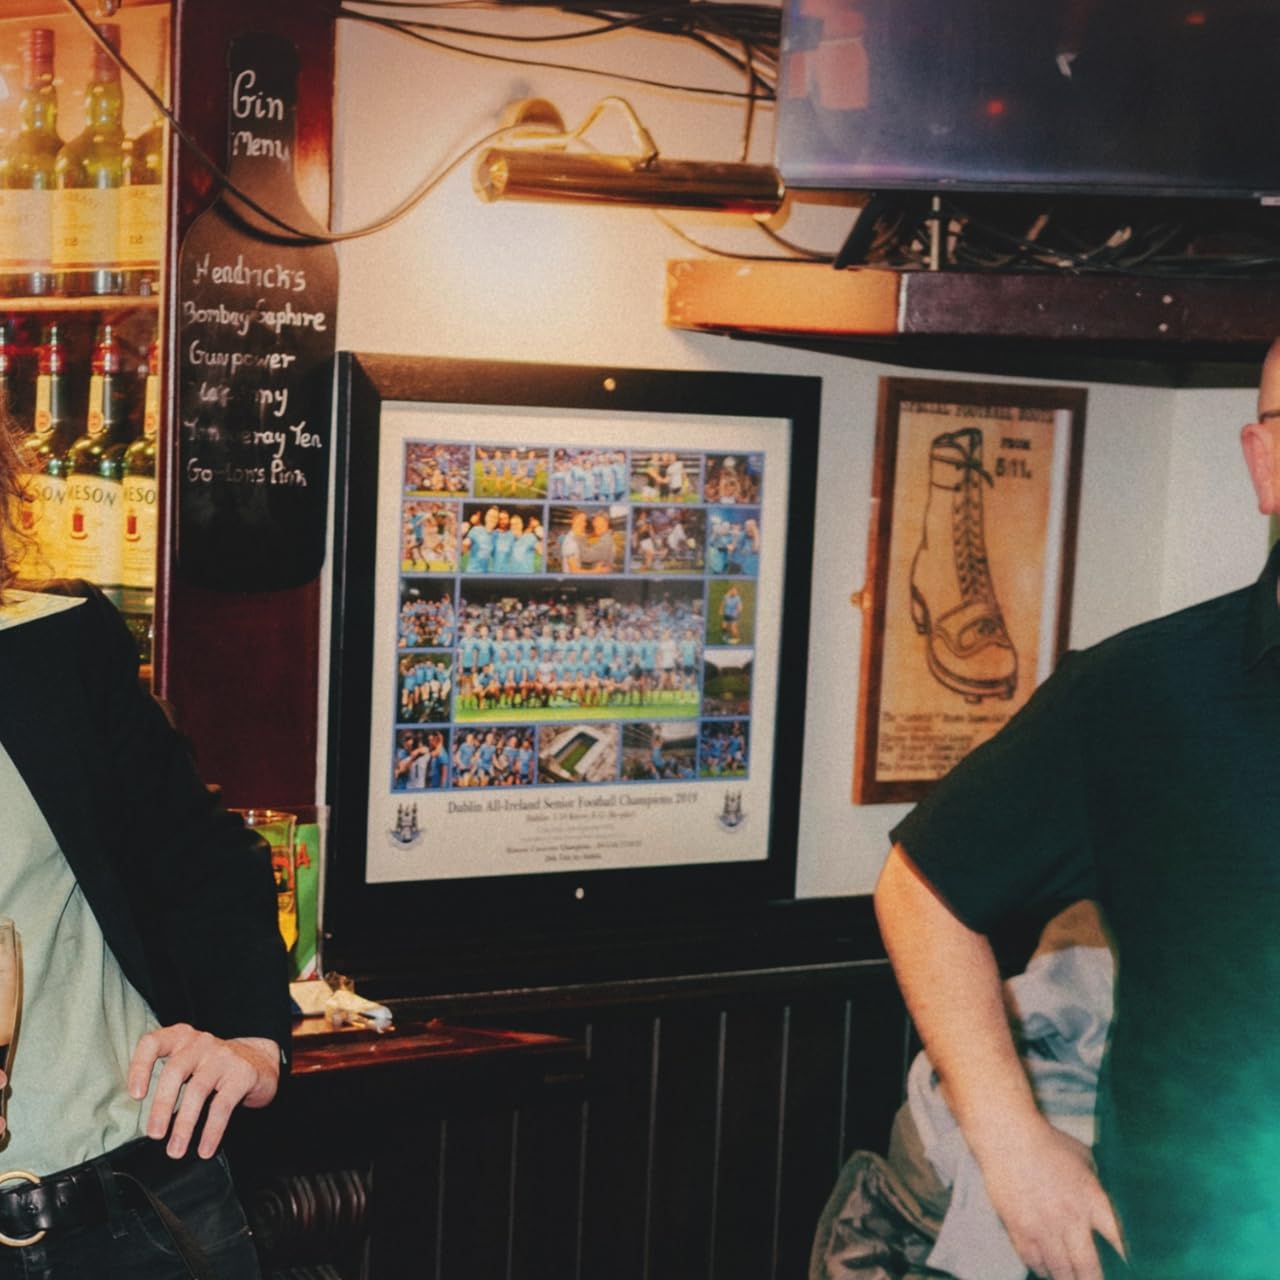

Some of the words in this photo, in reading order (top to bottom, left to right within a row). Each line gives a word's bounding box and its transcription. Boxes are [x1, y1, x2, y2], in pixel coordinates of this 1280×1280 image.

[233, 69, 284, 120] Gin
[231, 130, 290, 161] Menu
[192, 253, 307, 292] Hendrick's
[183, 301, 250, 336] Bombay
[290, 421, 323, 449] Ten
[270, 457, 308, 487] Pink
[447, 800, 483, 814] Dublin
[486, 797, 541, 812] All-Ireland
[543, 796, 575, 810] Senior
[578, 794, 617, 809] Football
[619, 793, 674, 809] Champions
